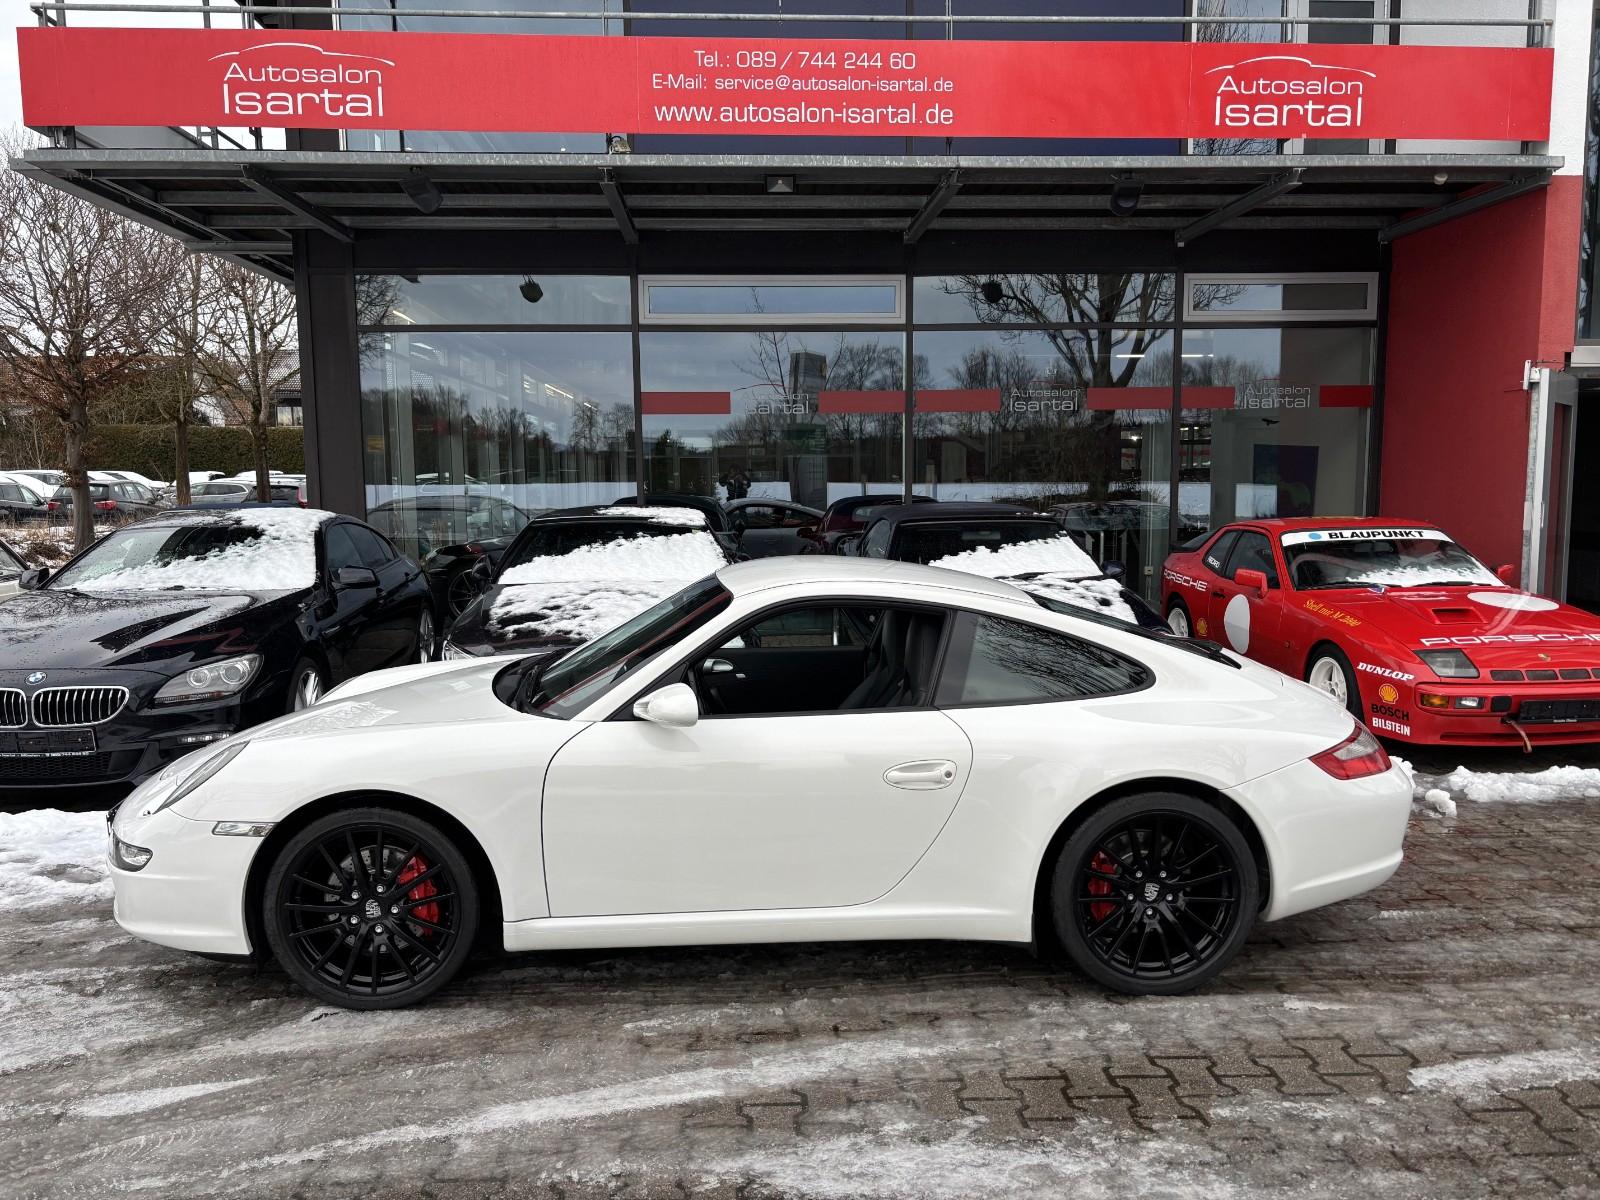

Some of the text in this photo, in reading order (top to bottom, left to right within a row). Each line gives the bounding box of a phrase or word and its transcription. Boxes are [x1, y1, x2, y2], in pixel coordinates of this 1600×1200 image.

[693, 50, 730, 68] Tel.:
[736, 50, 777, 69] 089
[798, 51, 837, 69] 744
[844, 52, 883, 69] 244
[889, 52, 916, 70] 60
[223, 62, 382, 84] Autosalon
[652, 73, 954, 93] E-Mail: service@autosalon-isartal.de
[1217, 75, 1363, 95] Autosalon
[223, 83, 384, 117] Isartal
[654, 101, 954, 125] www.autosalon-isartal.de
[1215, 95, 1362, 127] Isartal
[1010, 388, 1078, 397] Autosalon
[1246, 384, 1311, 395] Autosalon
[745, 400, 809, 415] sartal
[1009, 398, 1078, 412] Isartal
[1243, 394, 1311, 409] Isartal
[1327, 530, 1425, 540] BLAUPUNKT
[1163, 568, 1208, 592] PORSCHE
[1356, 661, 1415, 681] DUNLOP
[1371, 703, 1409, 721] BOSCH
[1372, 717, 1411, 737] BILSTEIN
